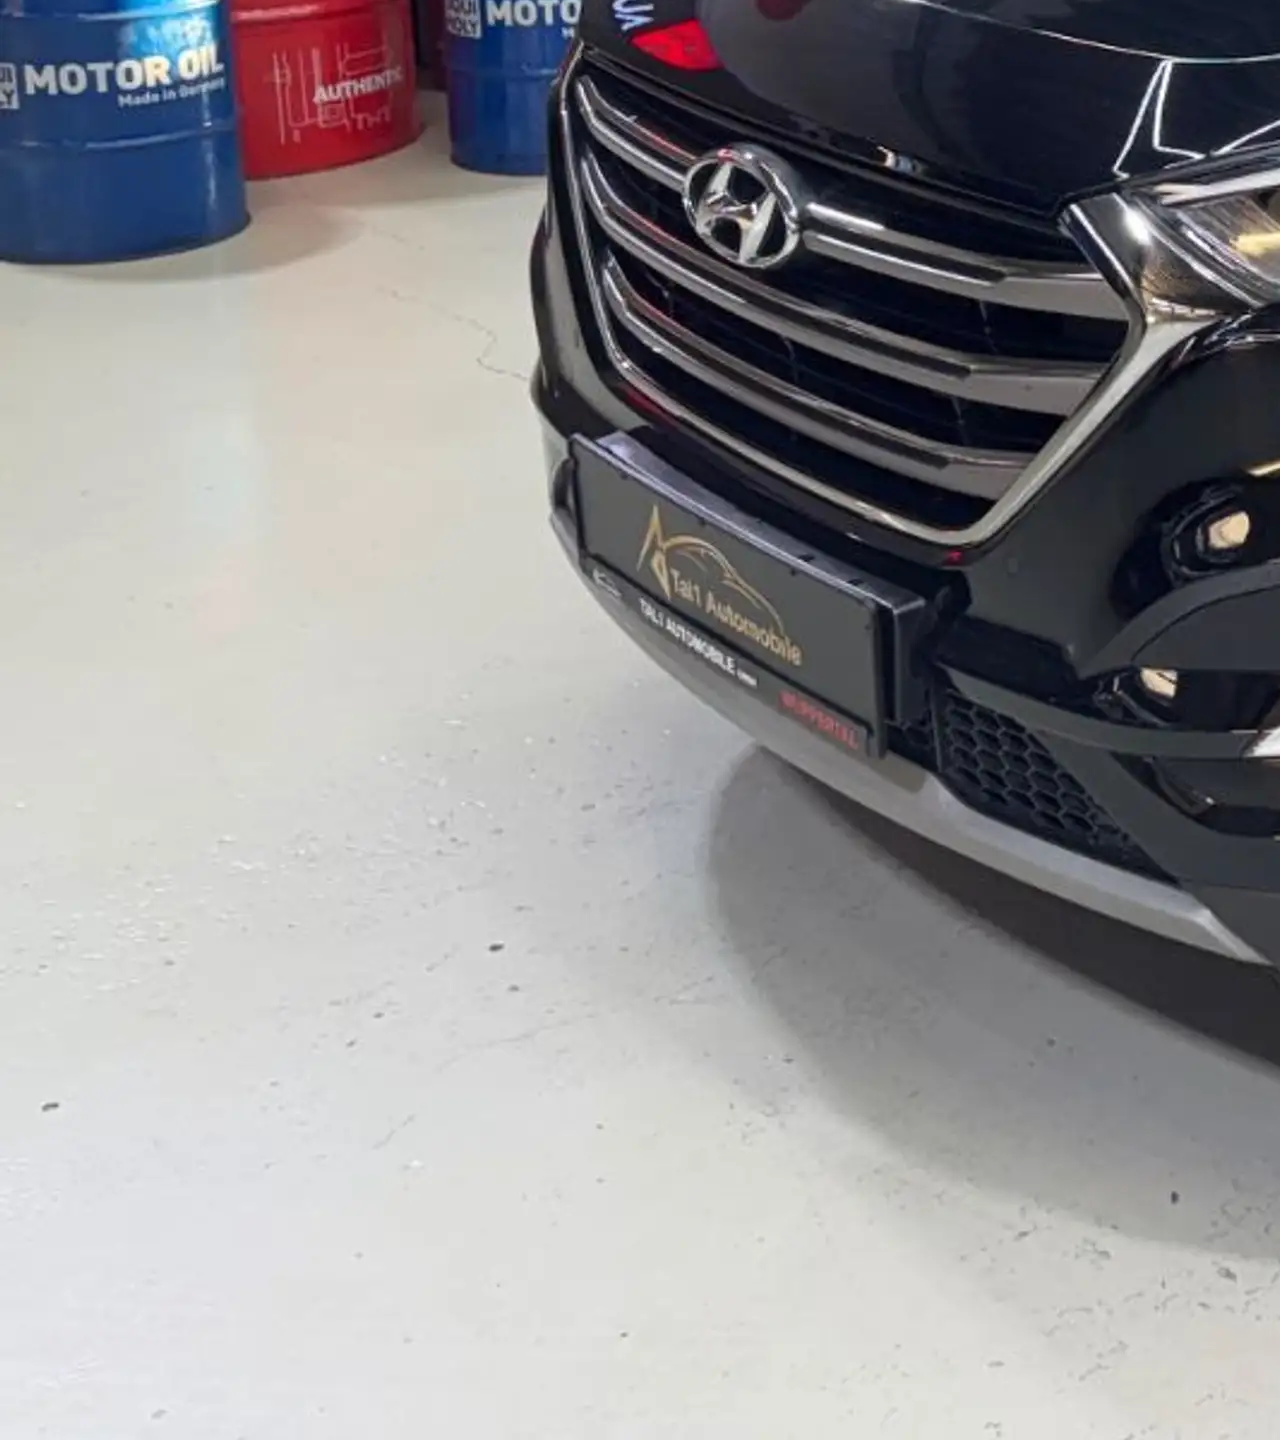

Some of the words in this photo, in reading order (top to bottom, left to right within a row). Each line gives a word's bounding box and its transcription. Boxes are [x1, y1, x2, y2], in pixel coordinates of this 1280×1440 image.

[24, 55, 172, 96] MOTOR
[178, 43, 224, 81] OIL
[117, 90, 160, 108] Made
[162, 87, 177, 101] in
[705, 590, 802, 667] Automobile
